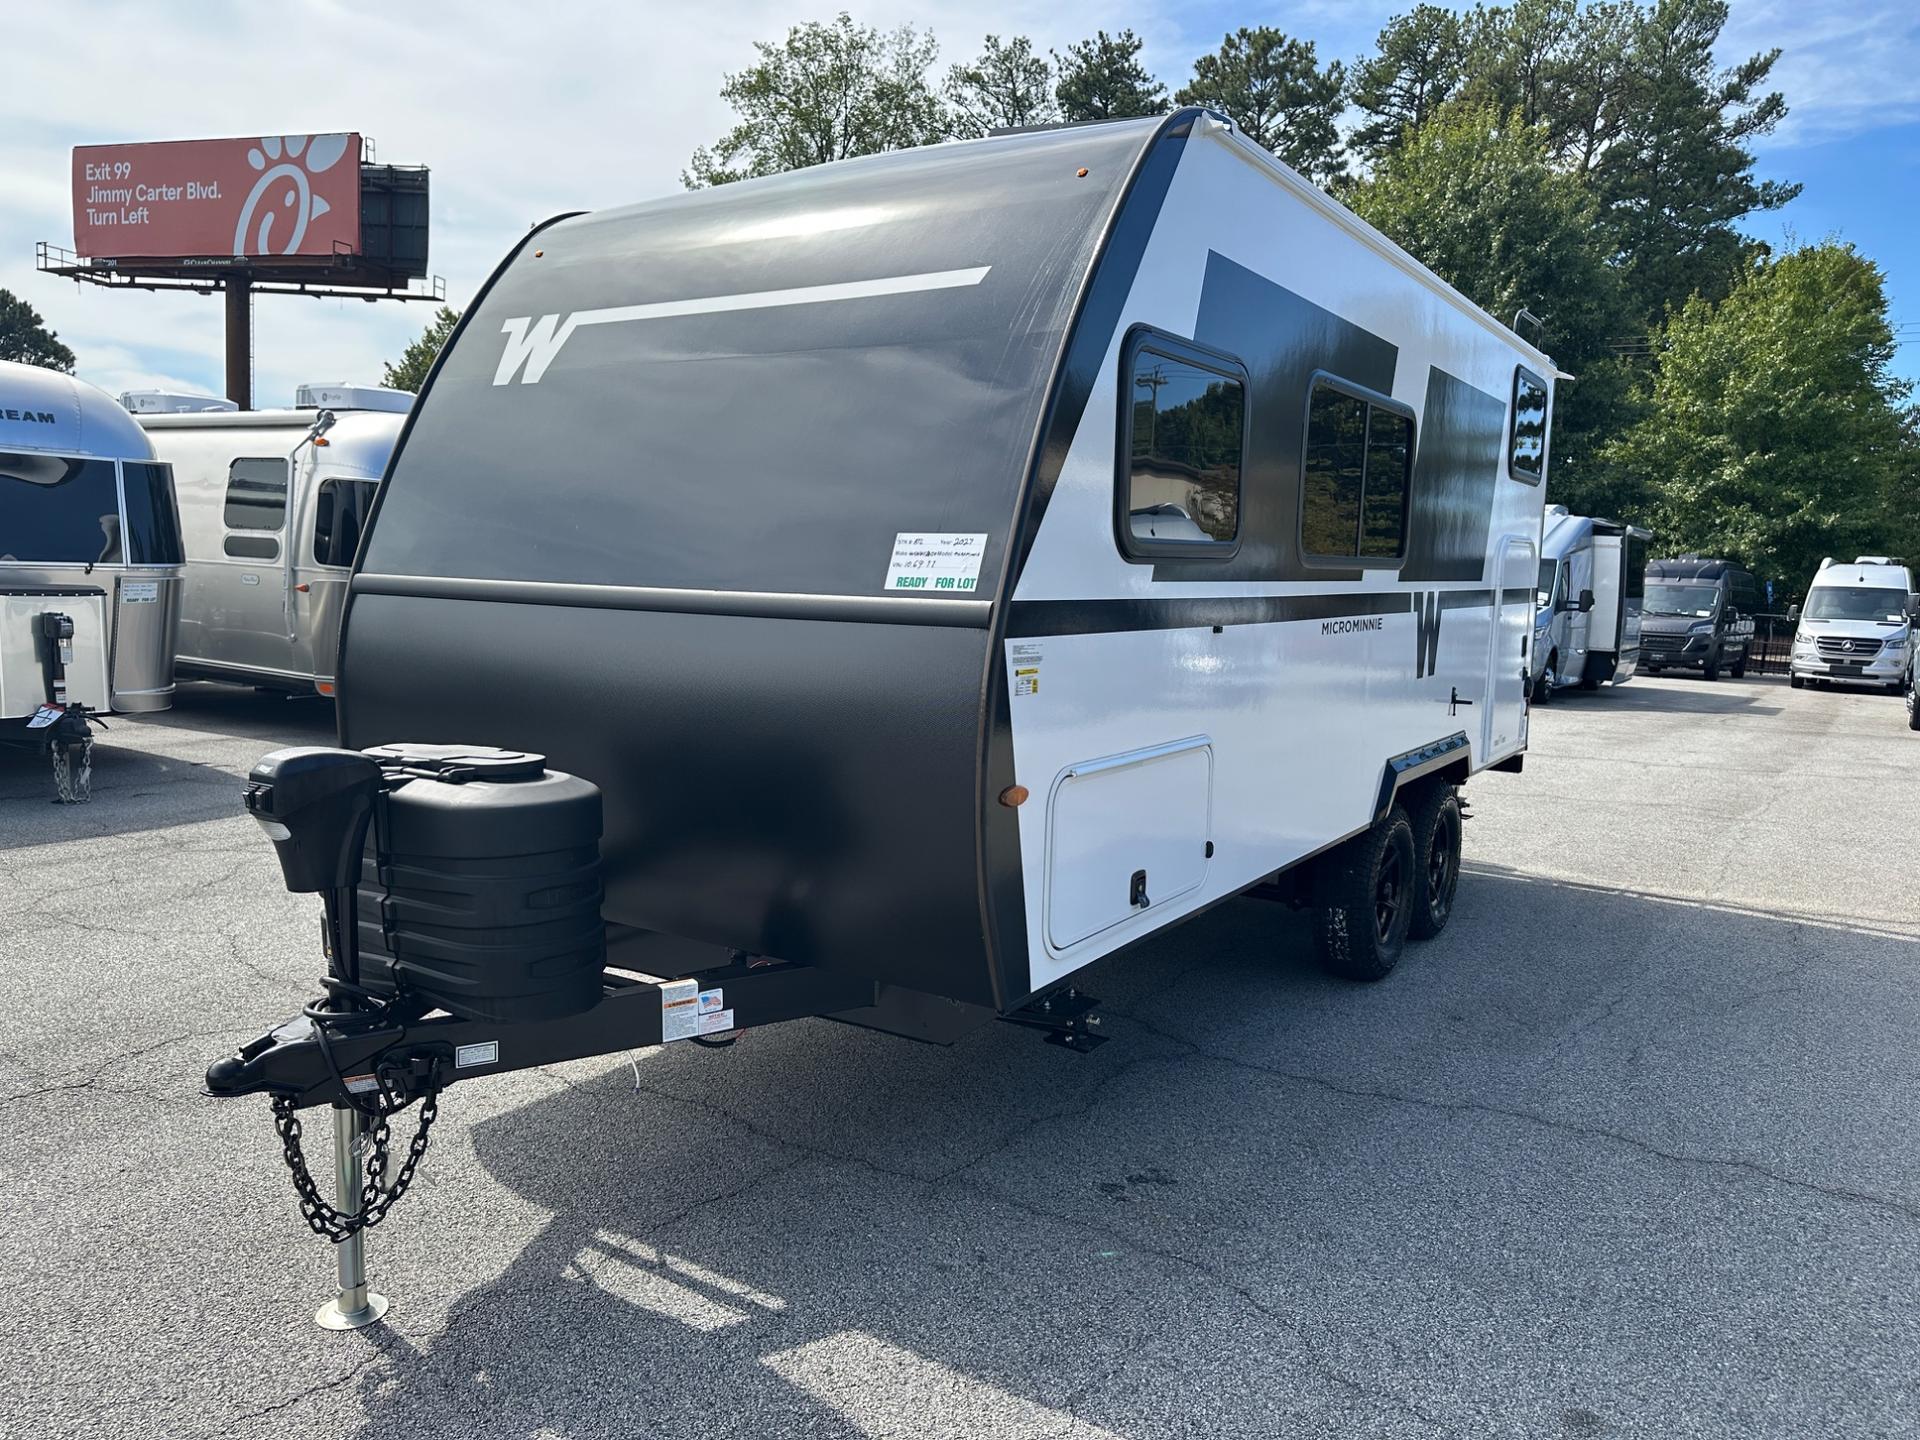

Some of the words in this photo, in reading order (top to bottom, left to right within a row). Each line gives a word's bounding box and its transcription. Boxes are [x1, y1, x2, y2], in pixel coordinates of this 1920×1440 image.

[85, 163, 111, 181] Exit
[114, 161, 131, 180] 99
[86, 185, 132, 206] Jimmy
[135, 183, 184, 201] Carter
[187, 181, 222, 199] Blvd.
[86, 208, 117, 226] Turn
[121, 206, 149, 224] Left
[0, 408, 56, 425] EAM
[896, 576, 928, 588] READY
[935, 577, 955, 588] FOR
[957, 578, 976, 589] LOT
[1321, 617, 1383, 636] MICROMINNIE
